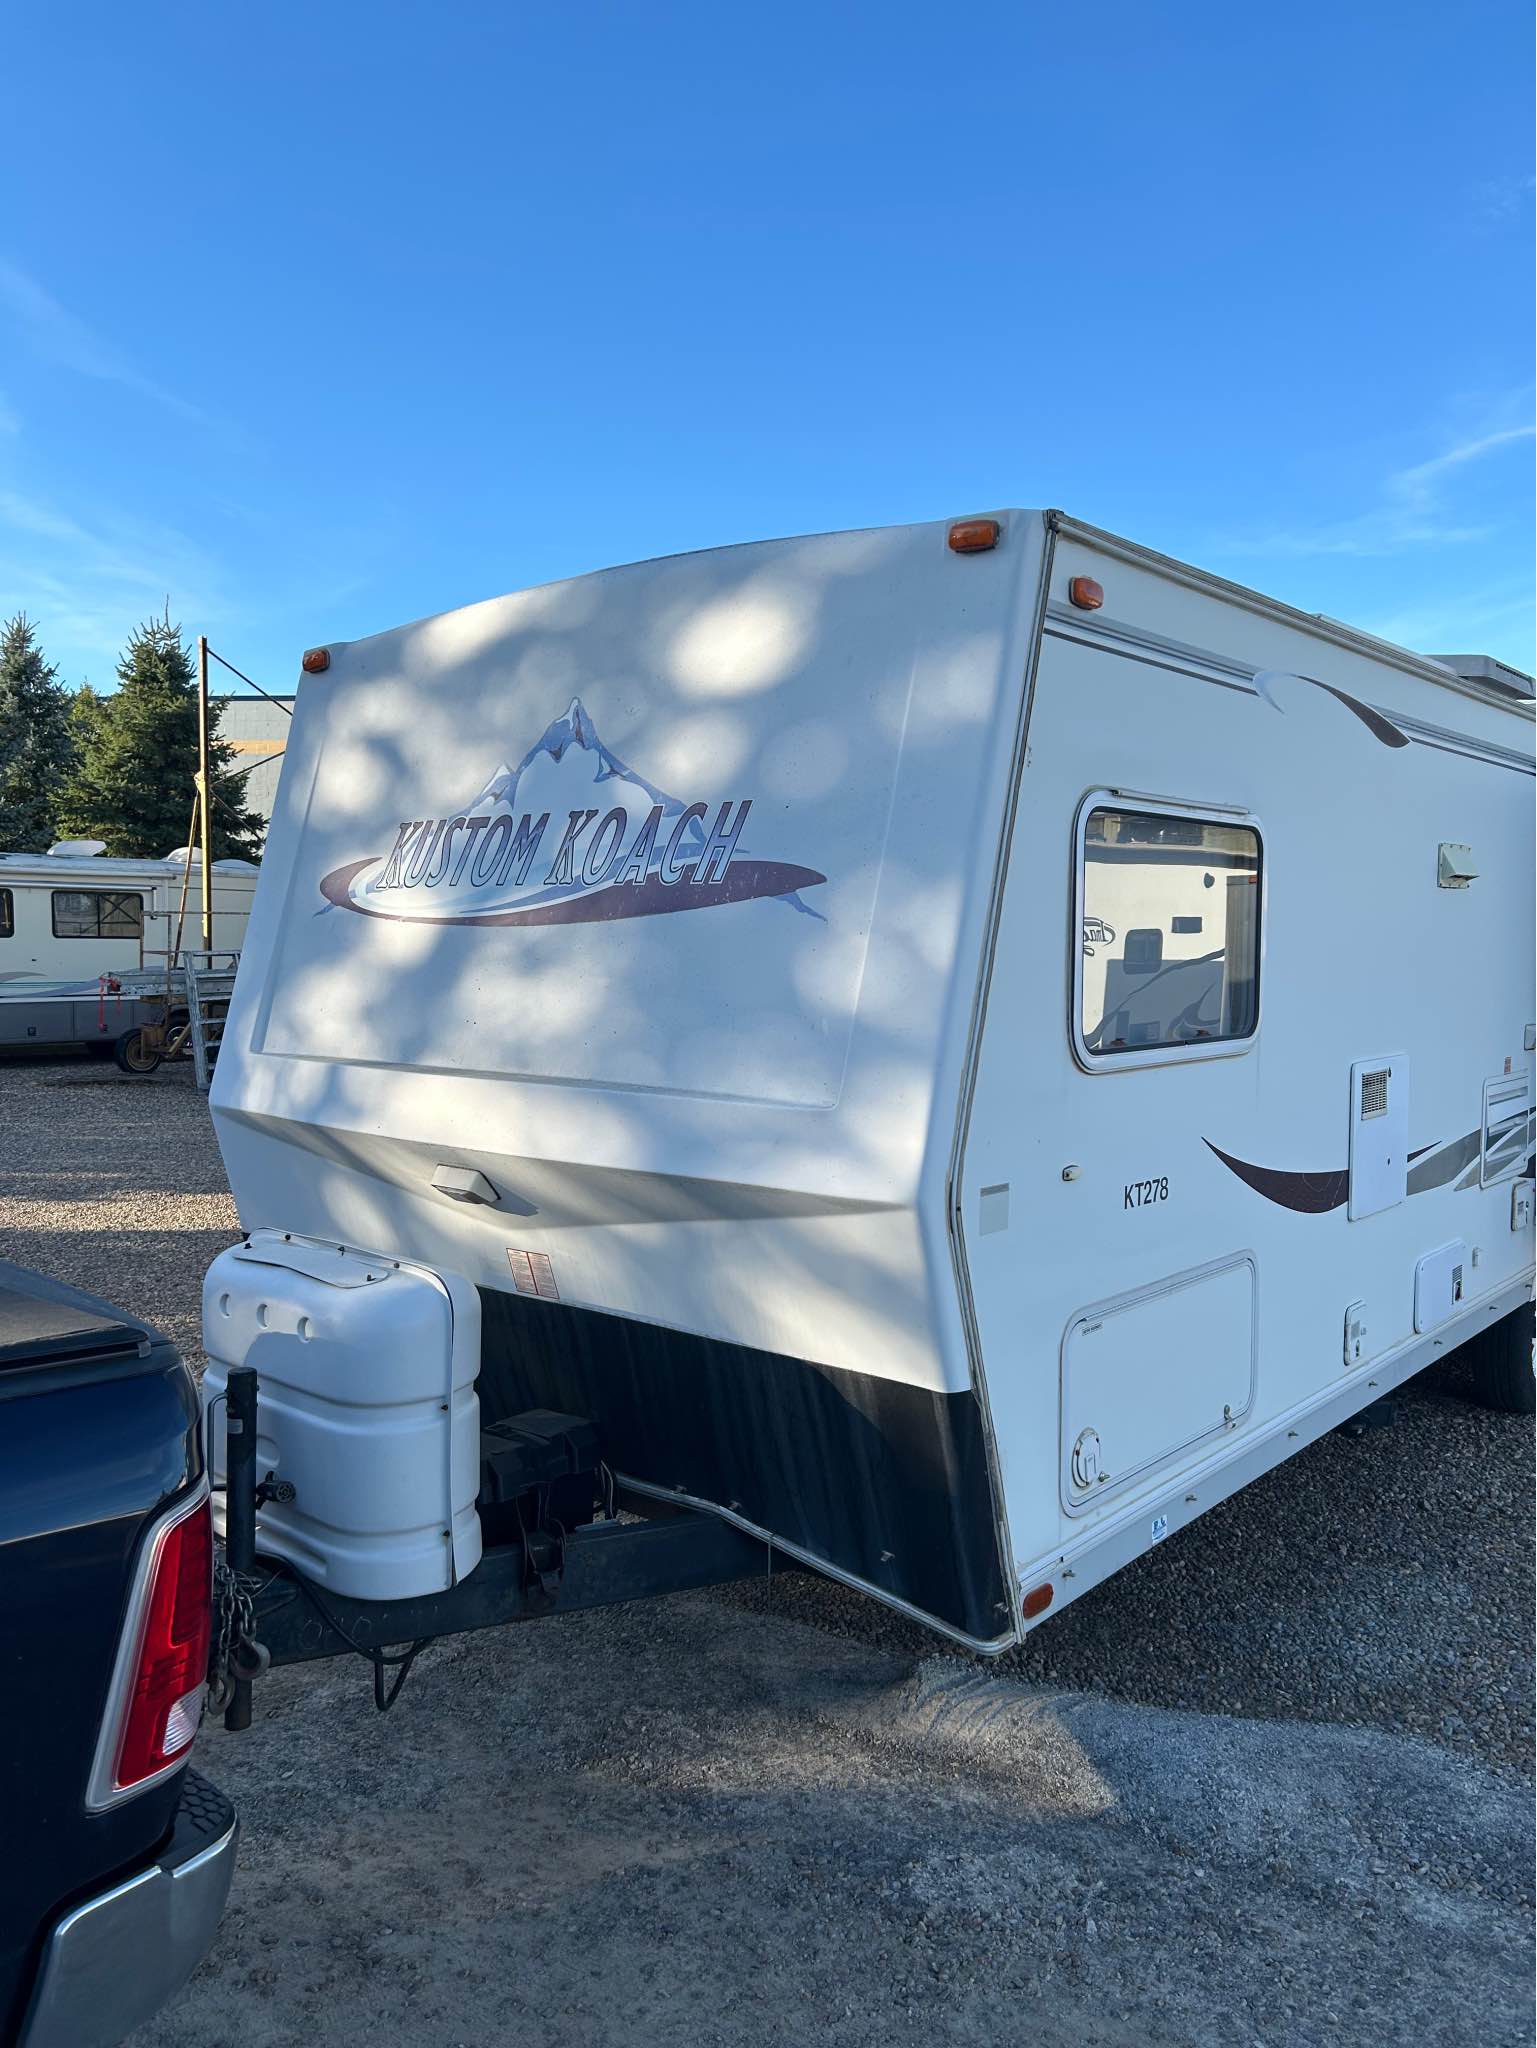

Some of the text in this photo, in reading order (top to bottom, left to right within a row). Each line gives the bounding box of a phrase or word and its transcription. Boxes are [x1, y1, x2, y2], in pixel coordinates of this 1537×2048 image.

[376, 799, 754, 890] KUSTOM KOACH
[1124, 1176, 1169, 1210] KT278
